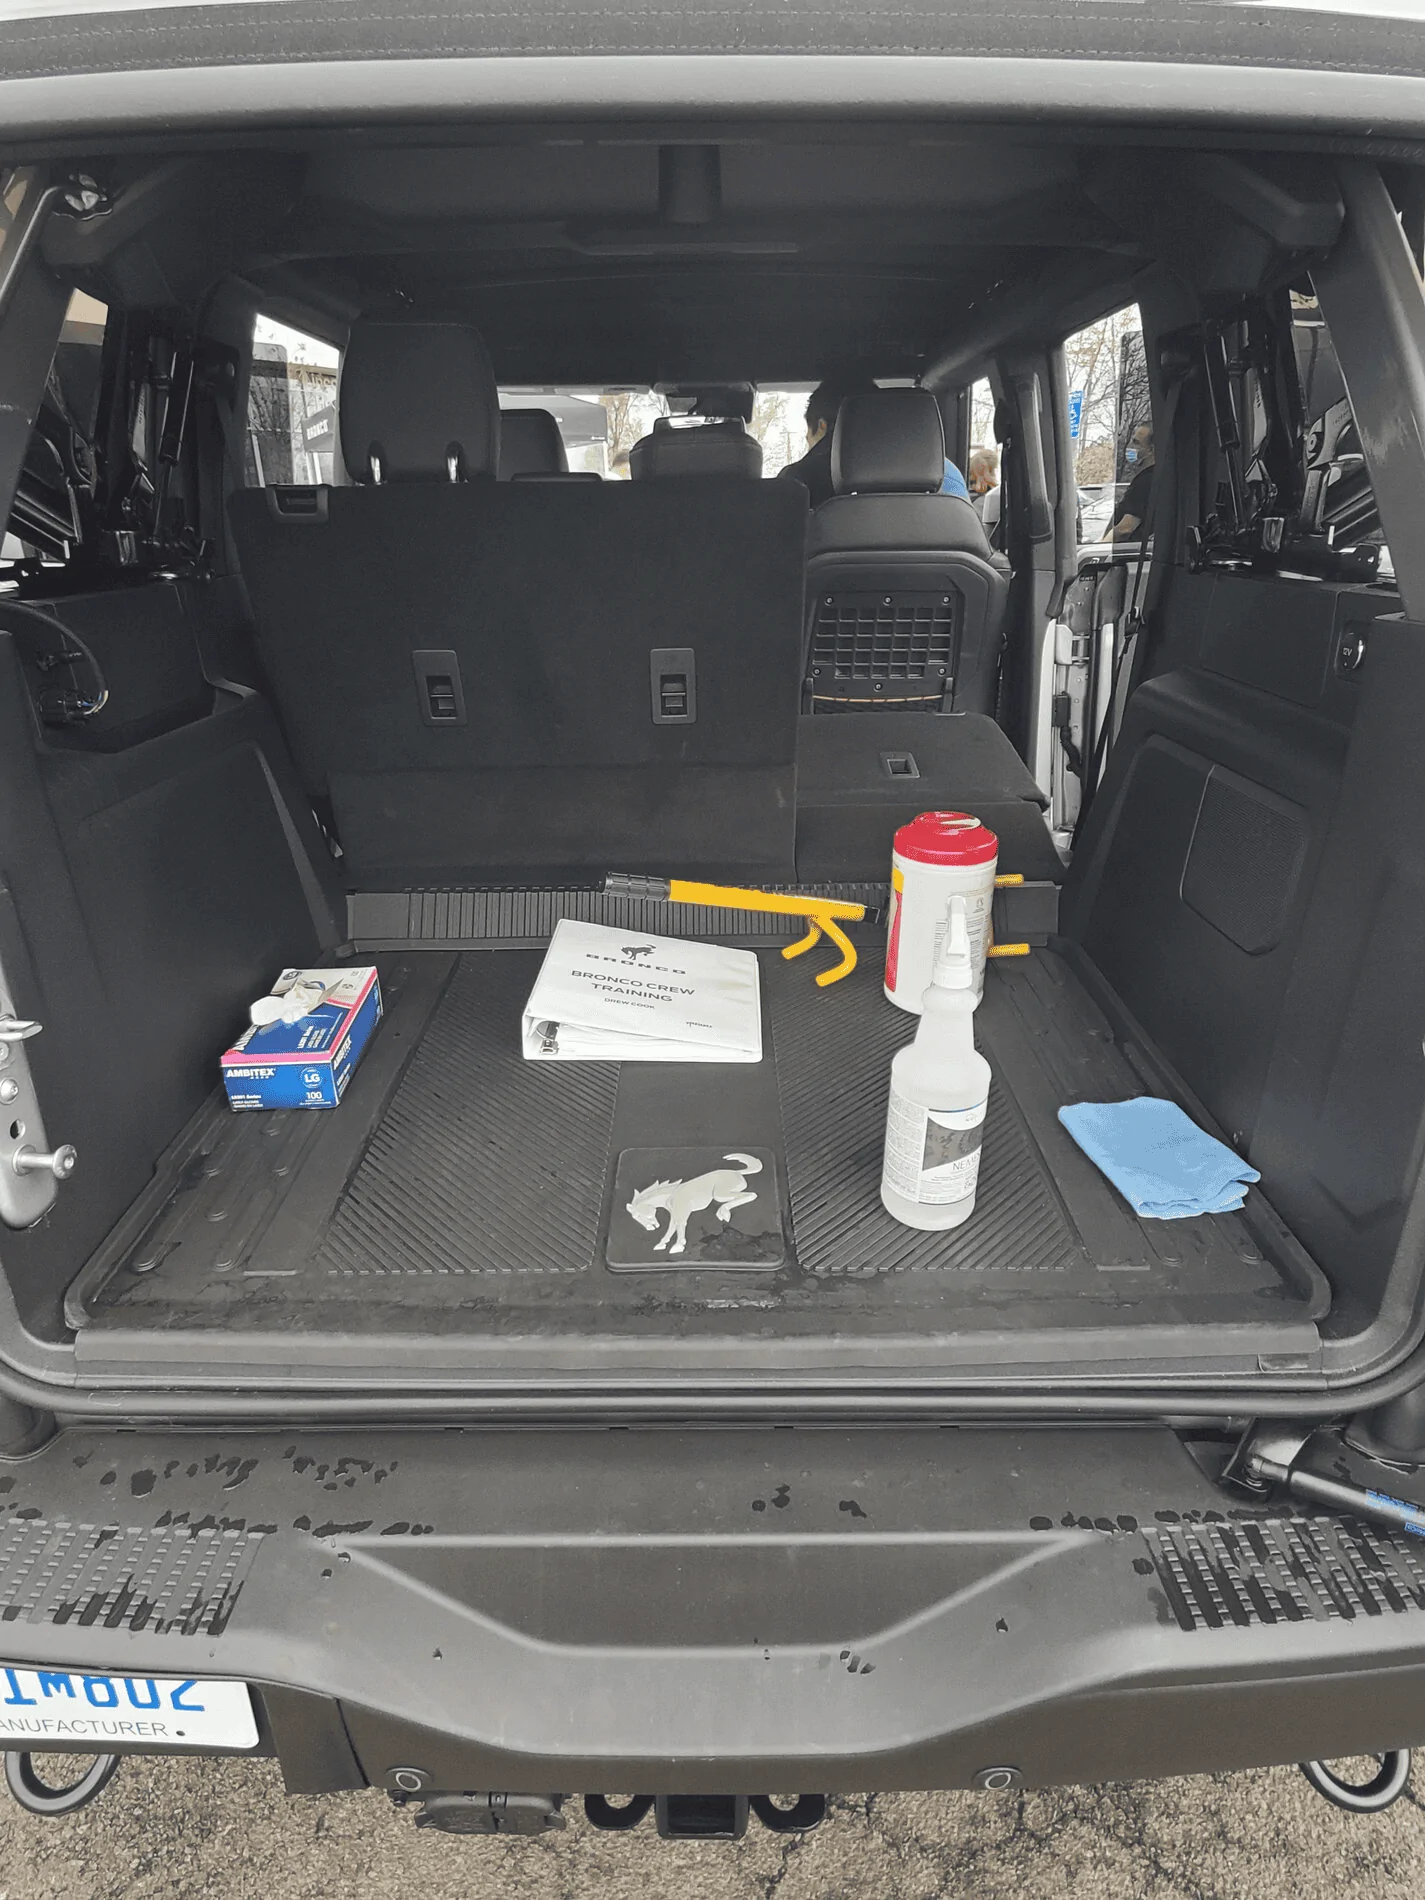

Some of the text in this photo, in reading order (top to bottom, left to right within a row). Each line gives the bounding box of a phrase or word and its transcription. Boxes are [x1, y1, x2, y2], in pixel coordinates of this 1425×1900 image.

[586, 953, 686, 975] BRONCO
[571, 970, 696, 996] BRONCO CREW
[591, 983, 673, 1002] TRAINING
[604, 998, 630, 1006] DREW
[227, 1067, 274, 1078] AMBITEX
[304, 1073, 321, 1083] LG
[306, 1091, 323, 1100] 100
